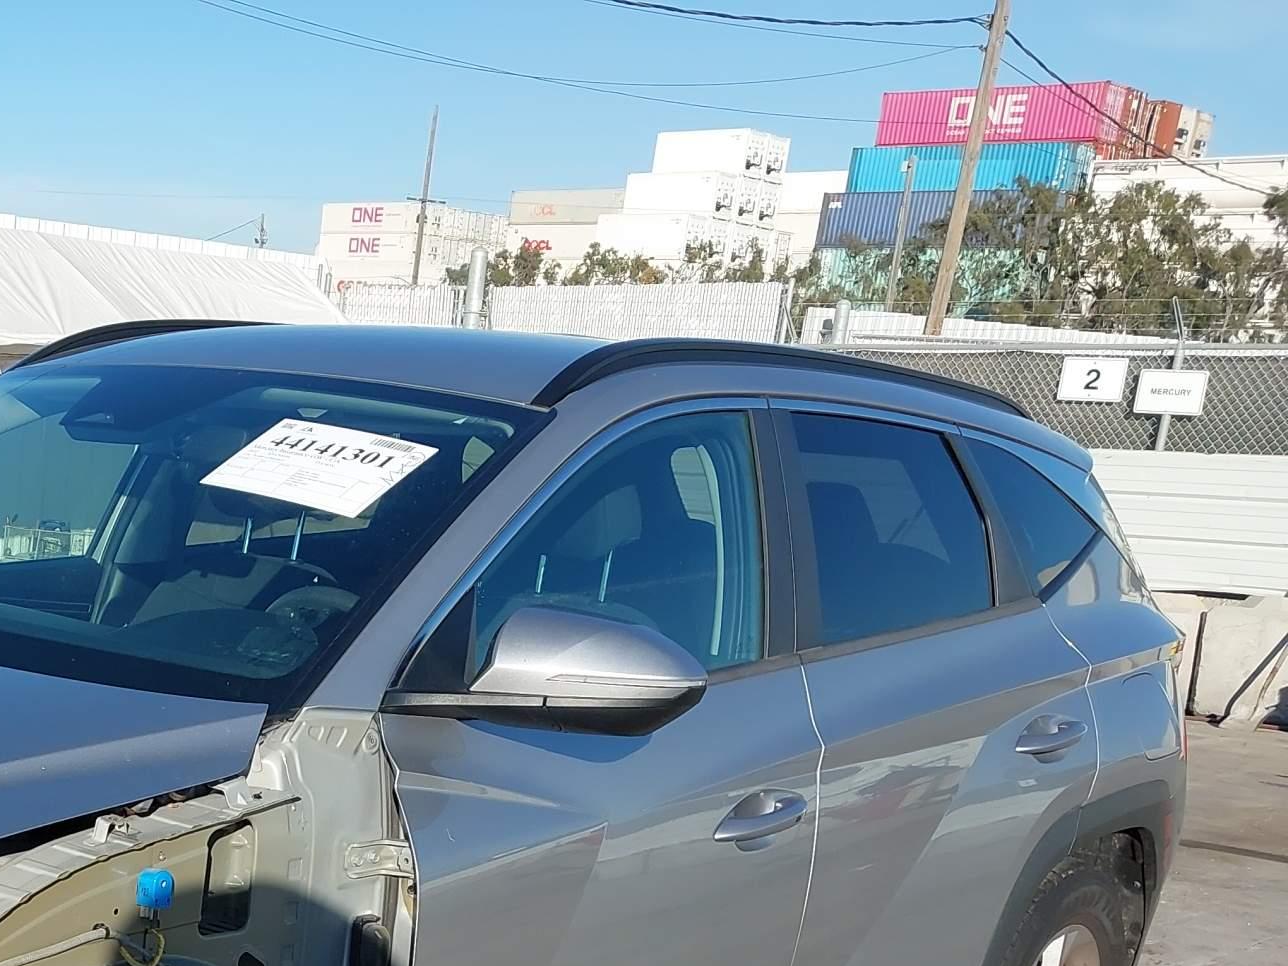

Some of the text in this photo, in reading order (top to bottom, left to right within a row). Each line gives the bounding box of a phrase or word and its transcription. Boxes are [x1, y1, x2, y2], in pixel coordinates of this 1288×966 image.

[948, 93, 1029, 127] ONE
[351, 206, 384, 223] ONE
[348, 237, 380, 253] ONE
[1083, 368, 1101, 390] 2
[1150, 387, 1192, 396] MERCURY
[270, 435, 395, 468] 44141301
